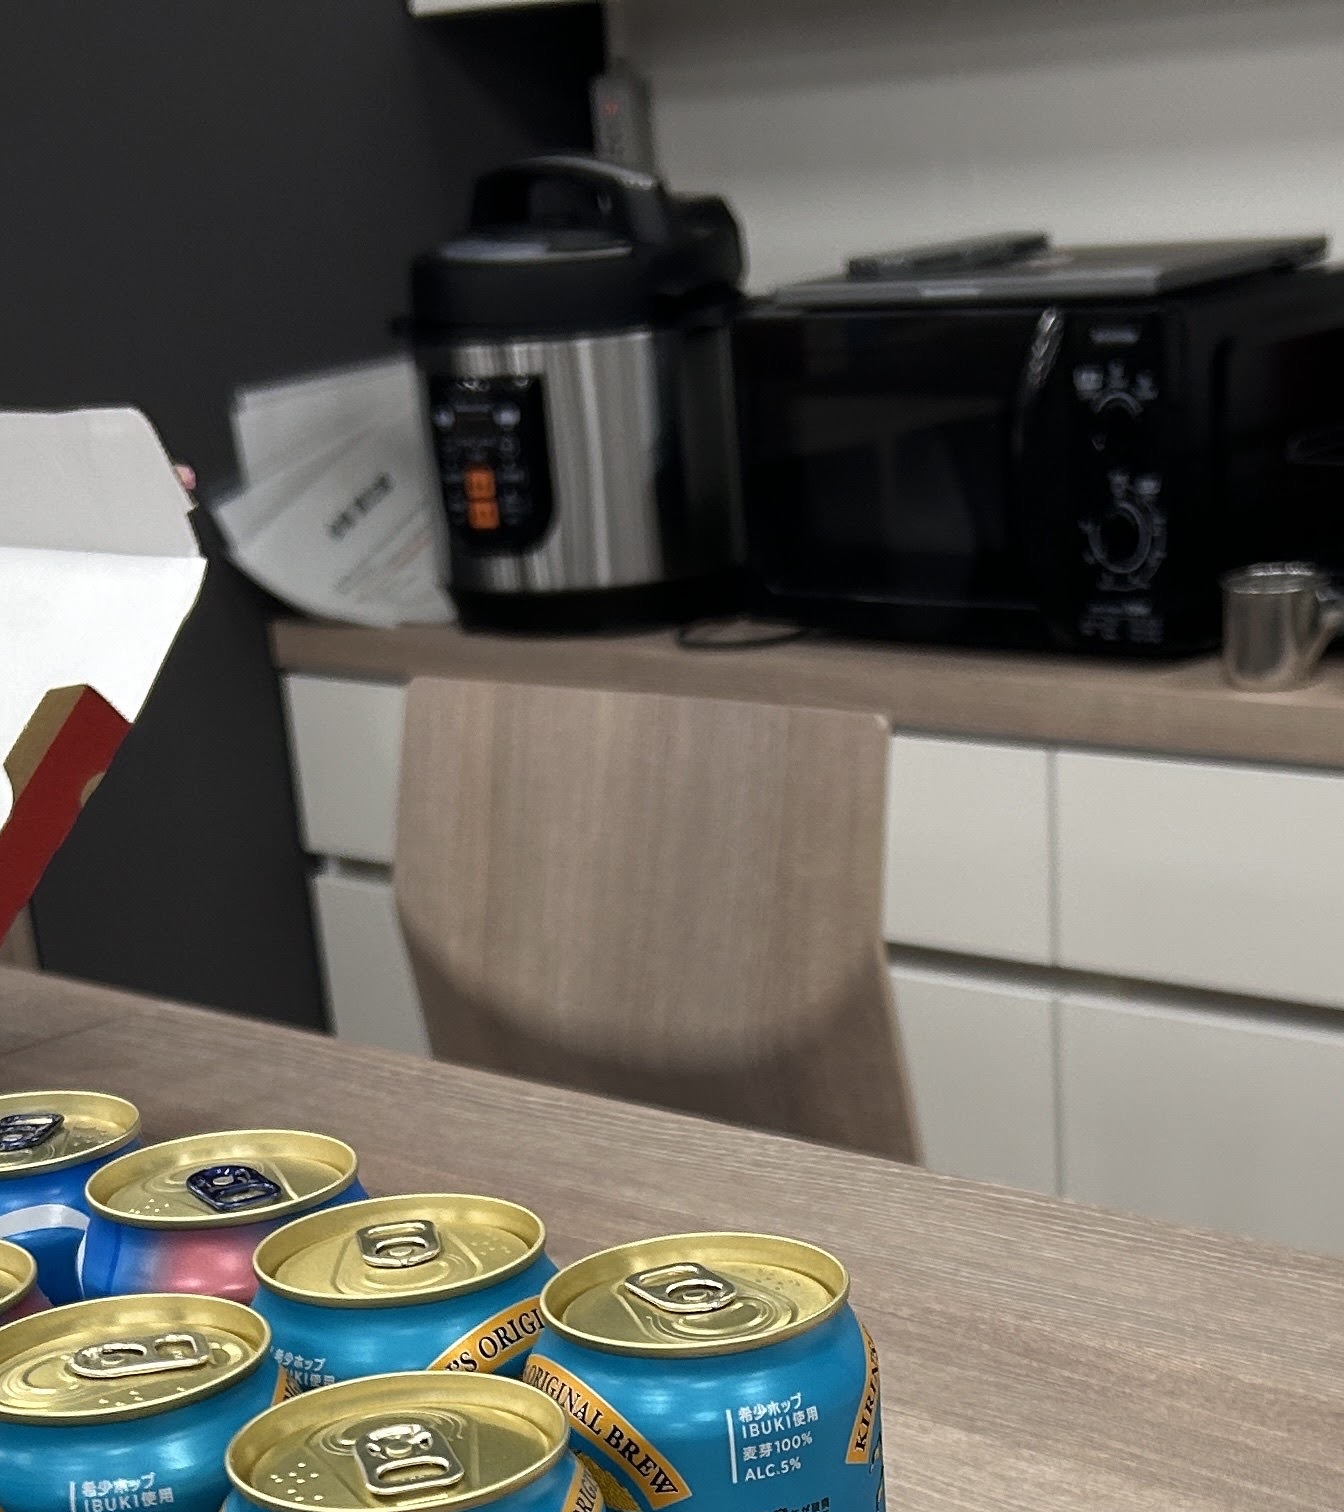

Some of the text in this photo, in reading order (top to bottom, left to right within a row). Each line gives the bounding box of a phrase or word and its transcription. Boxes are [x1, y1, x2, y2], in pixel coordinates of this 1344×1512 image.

[742, 1405, 819, 1439] IBUKI使用
[603, 1424, 679, 1496] BREW
[743, 1431, 813, 1462] 麦芽100%
[744, 1456, 802, 1482] ALC.5%
